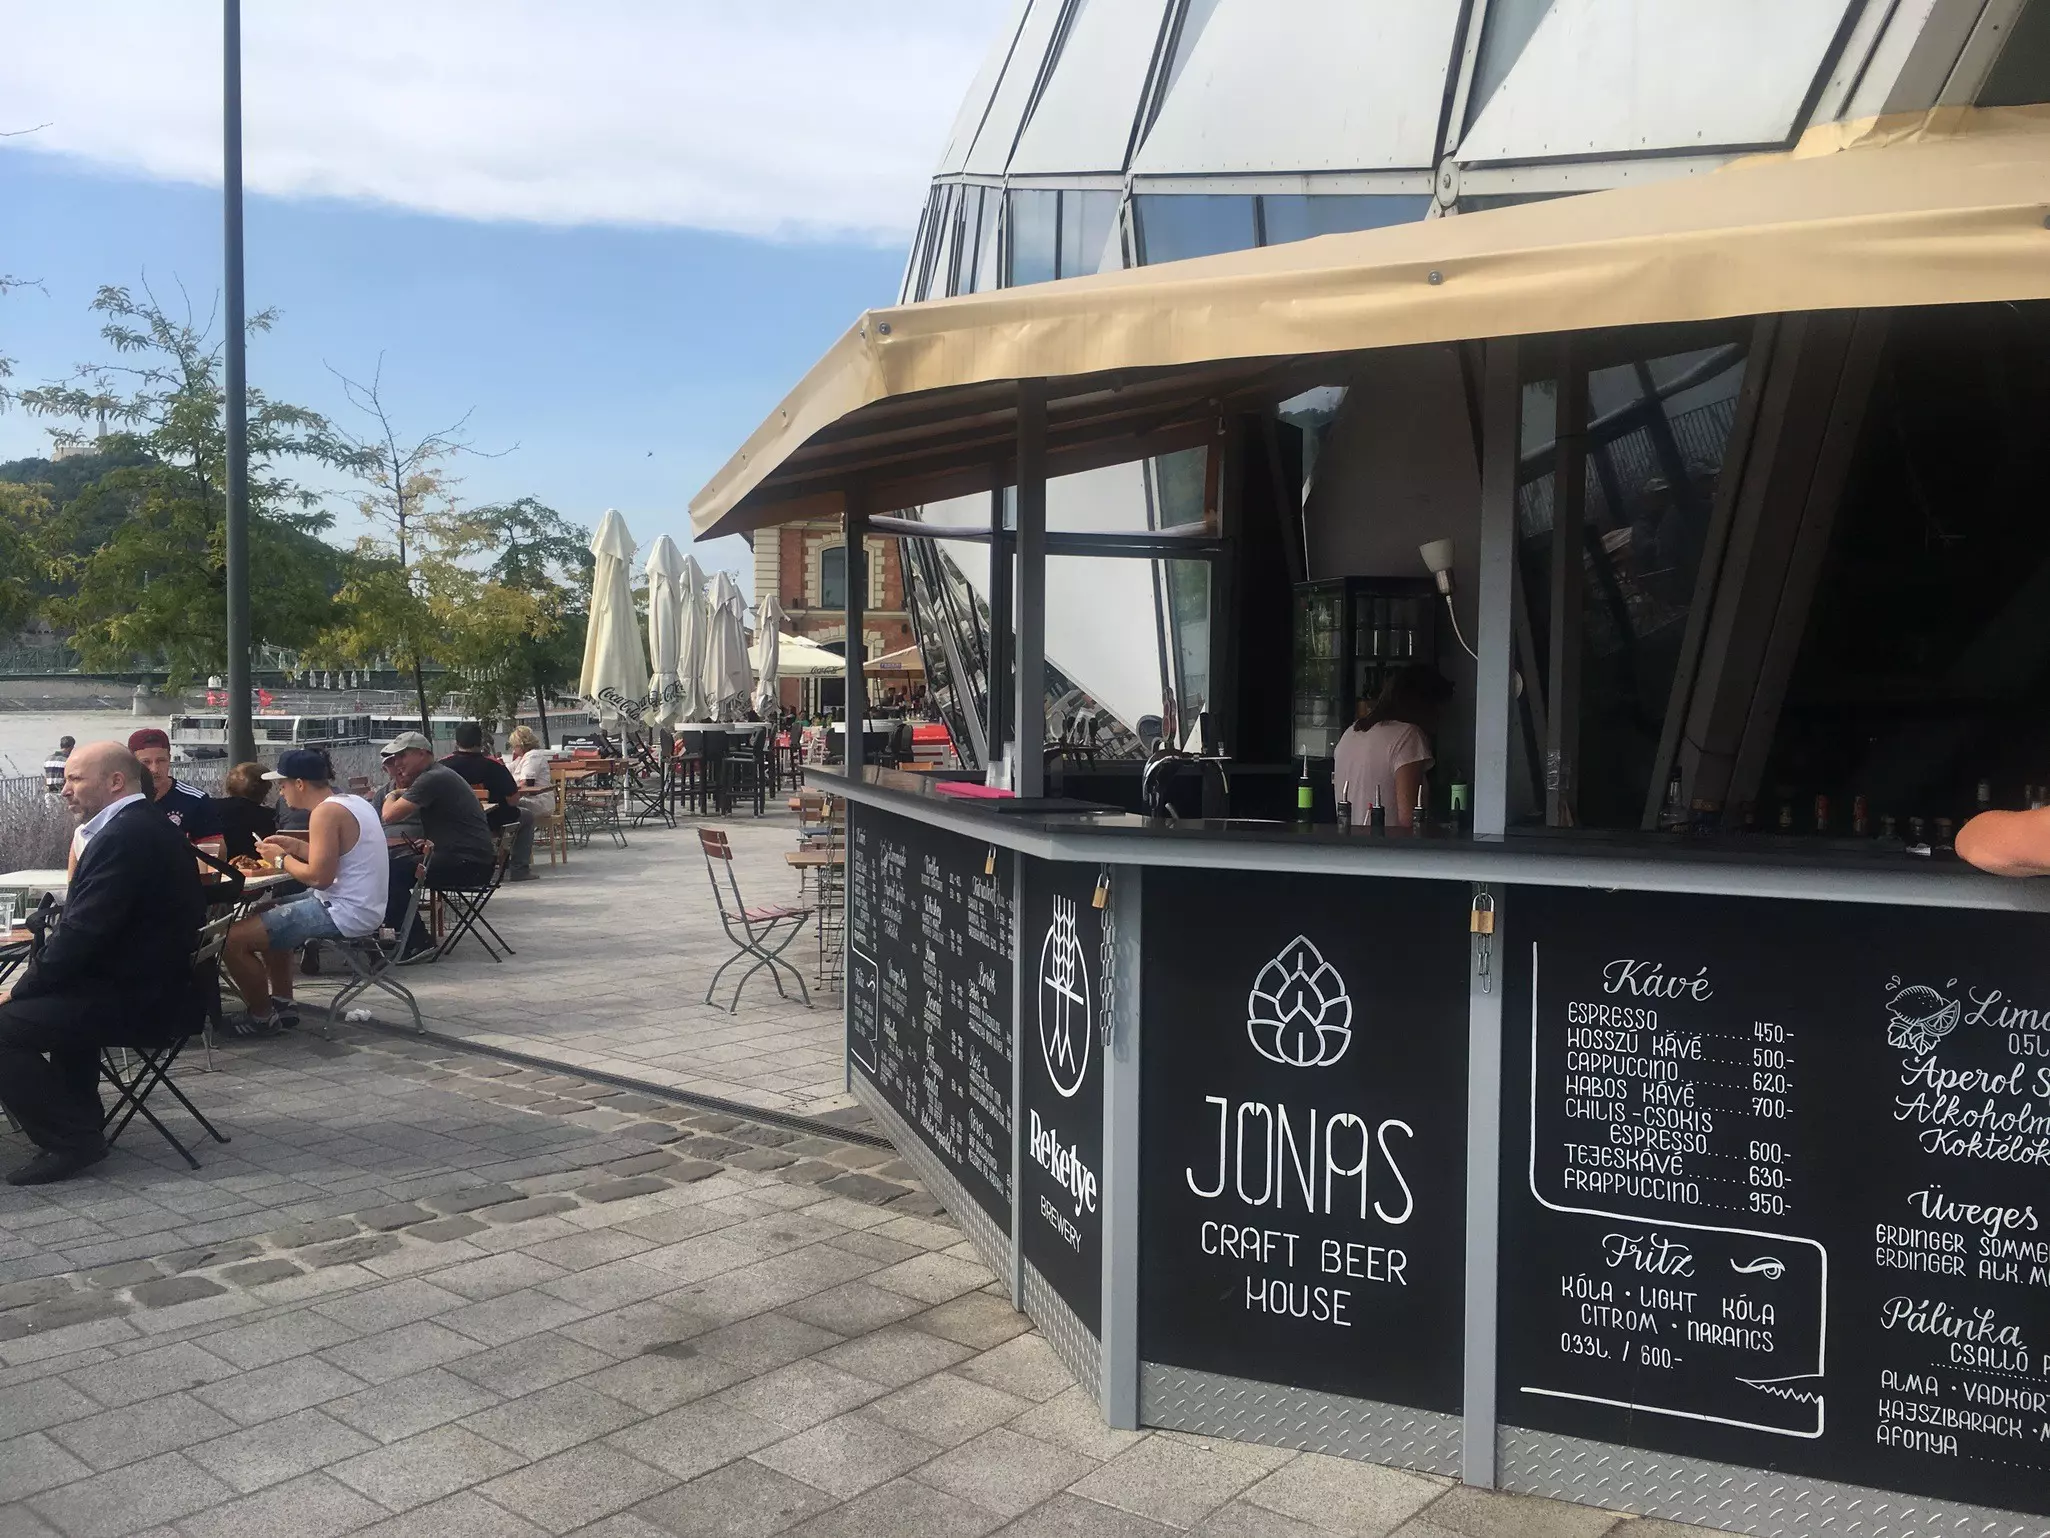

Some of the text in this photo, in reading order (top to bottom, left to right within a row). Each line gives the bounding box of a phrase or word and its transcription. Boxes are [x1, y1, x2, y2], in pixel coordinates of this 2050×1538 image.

[1603, 959, 1714, 1002] Kávé
[1567, 1001, 1795, 1044] ESPRESSO 450.-
[1567, 1028, 1795, 1070] HOSSZÚ KÁVÉ 500.-
[1567, 1051, 1794, 1094] CAPPUCCINO 620.-
[1901, 1055, 2025, 1097] Aperol
[1565, 1098, 1626, 1122] CHILIS
[1566, 1075, 1794, 1119] HABOS KÁVÉ 700.-
[1029, 1108, 1097, 1218] Reketye
[1186, 1094, 1414, 1225] JONAS
[1610, 1123, 1792, 1164] ESPRESSO 600.-
[1564, 1143, 1792, 1190] TEJESKÁVÉ 630.-
[1564, 1168, 1792, 1216] FRAPPUCCINO 950.-
[1907, 1184, 2039, 1238] Üveges
[1040, 1194, 1082, 1254] BREWERY
[1876, 1223, 2050, 1264] ERDINGER SOMME
[1201, 1221, 1408, 1286] CRAFT BEER
[1602, 1232, 1695, 1277] Fritz
[1876, 1247, 1967, 1277] ERDINGER
[1979, 1259, 2024, 1284] ALK.
[1246, 1276, 1351, 1327] HOUSE
[1561, 1273, 1775, 1326] KÓLA LIGHT KÓLA
[1581, 1303, 1774, 1352] CITROM NARANCS
[1880, 1296, 2025, 1347] Pálinka
[1950, 1341, 2028, 1372] CSALLÓ
[1881, 1370, 1939, 1397] ALMA
[1876, 1418, 1958, 1456] ÁFONYA
[1879, 1399, 2023, 1439] KAJSZIBARACK
